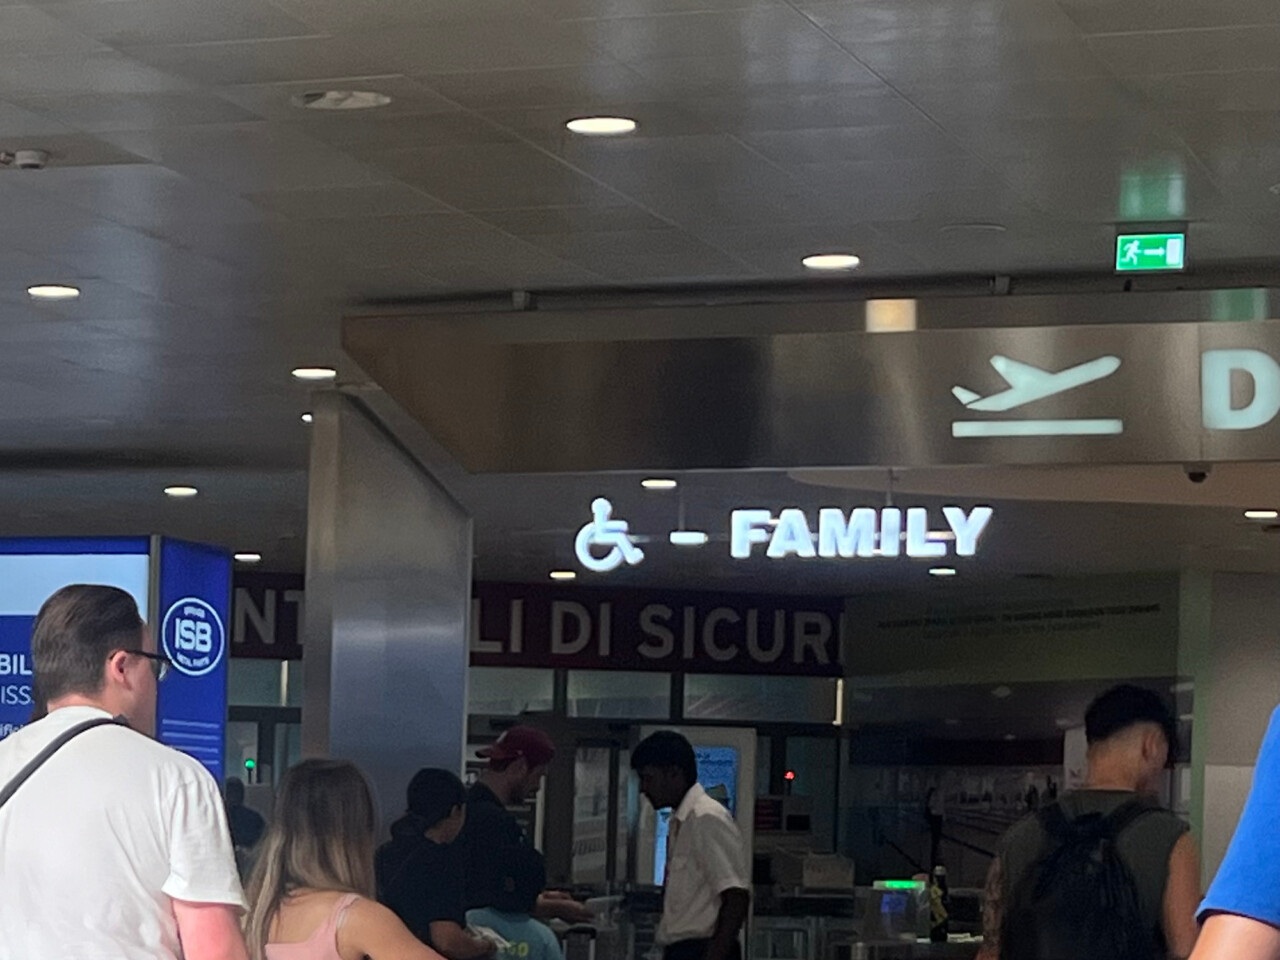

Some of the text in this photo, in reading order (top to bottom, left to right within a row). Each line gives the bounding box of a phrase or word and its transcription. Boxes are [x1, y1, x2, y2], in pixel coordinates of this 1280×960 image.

[1202, 349, 1280, 429] D
[730, 506, 994, 558] FAMILY
[175, 617, 212, 653] ISB
[233, 587, 306, 645] NT
[469, 597, 524, 654] LI
[550, 599, 612, 657] DI
[637, 603, 846, 666] SICUR
